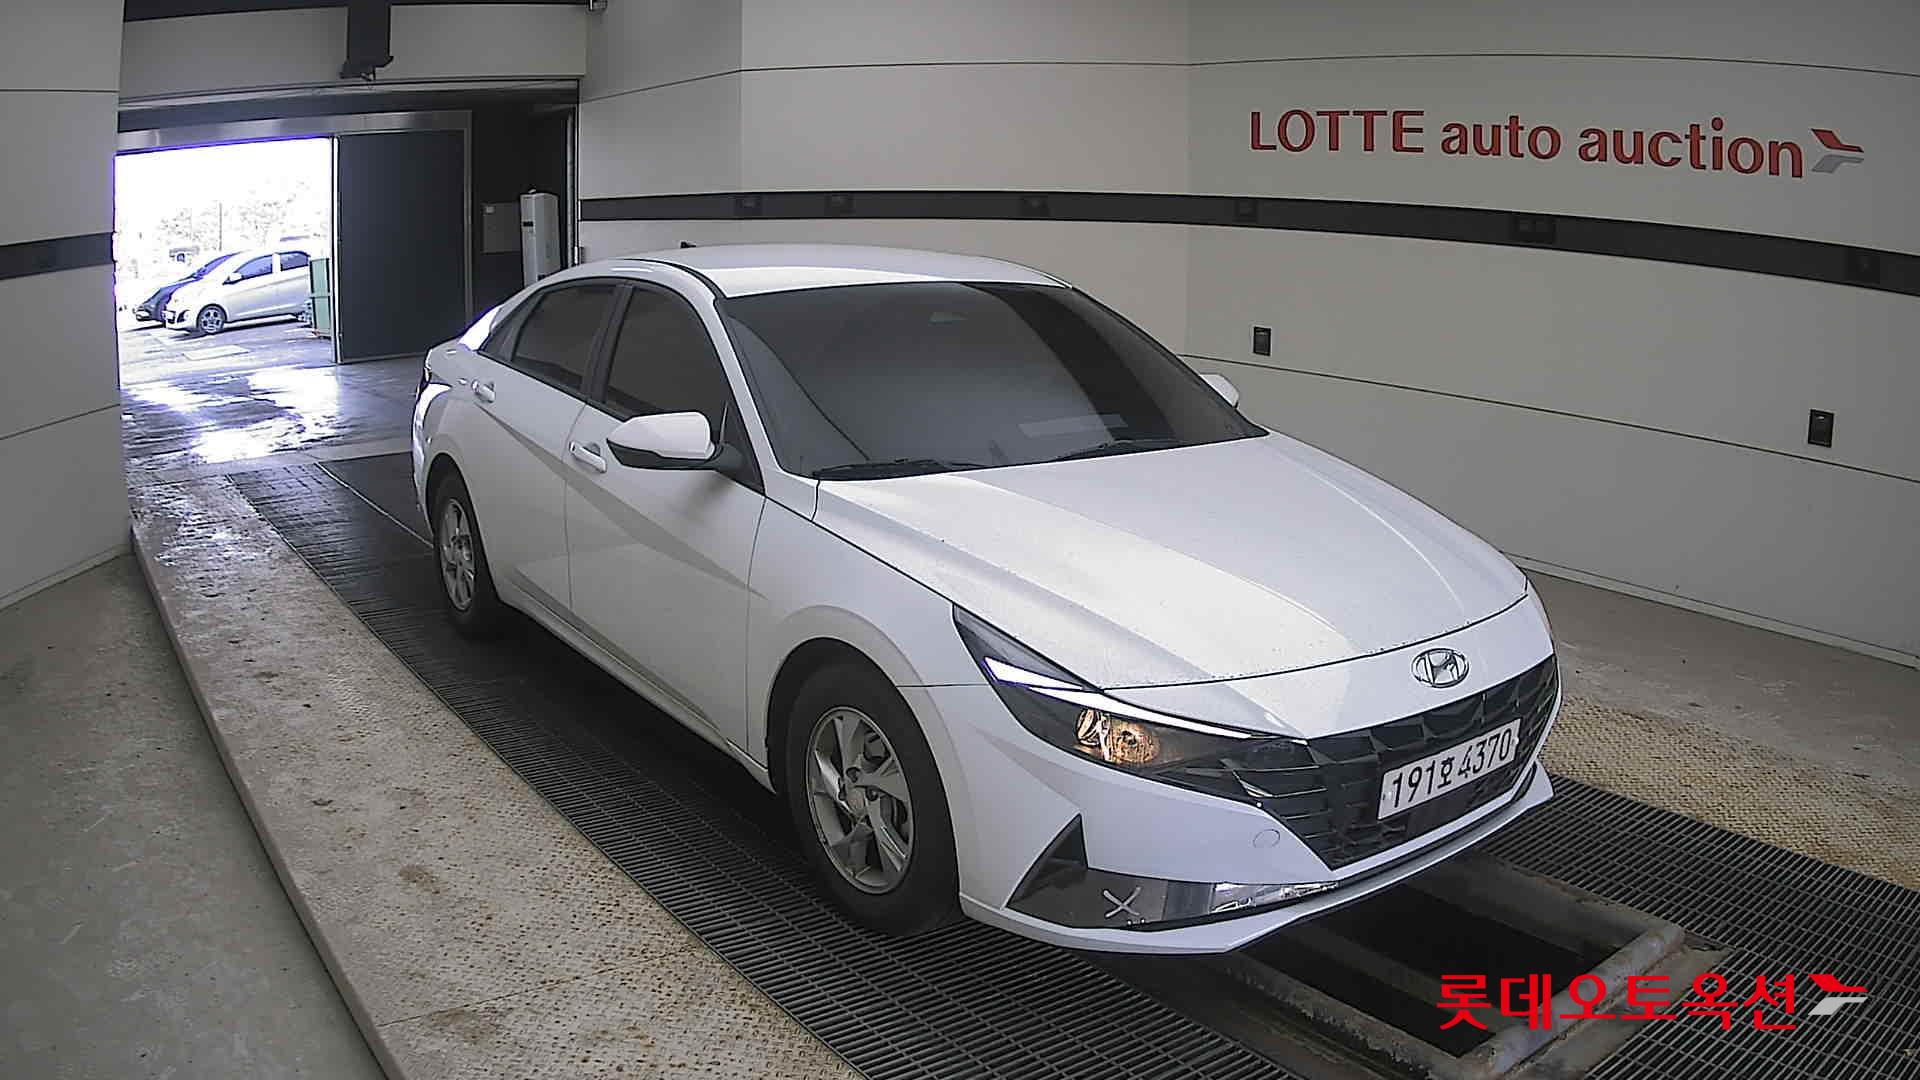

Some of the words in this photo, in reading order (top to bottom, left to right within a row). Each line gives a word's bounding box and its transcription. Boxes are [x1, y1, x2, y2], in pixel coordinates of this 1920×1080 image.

[1250, 110, 1425, 154] LOTTE
[1440, 115, 1562, 160] auto
[1577, 117, 1804, 178] auction
